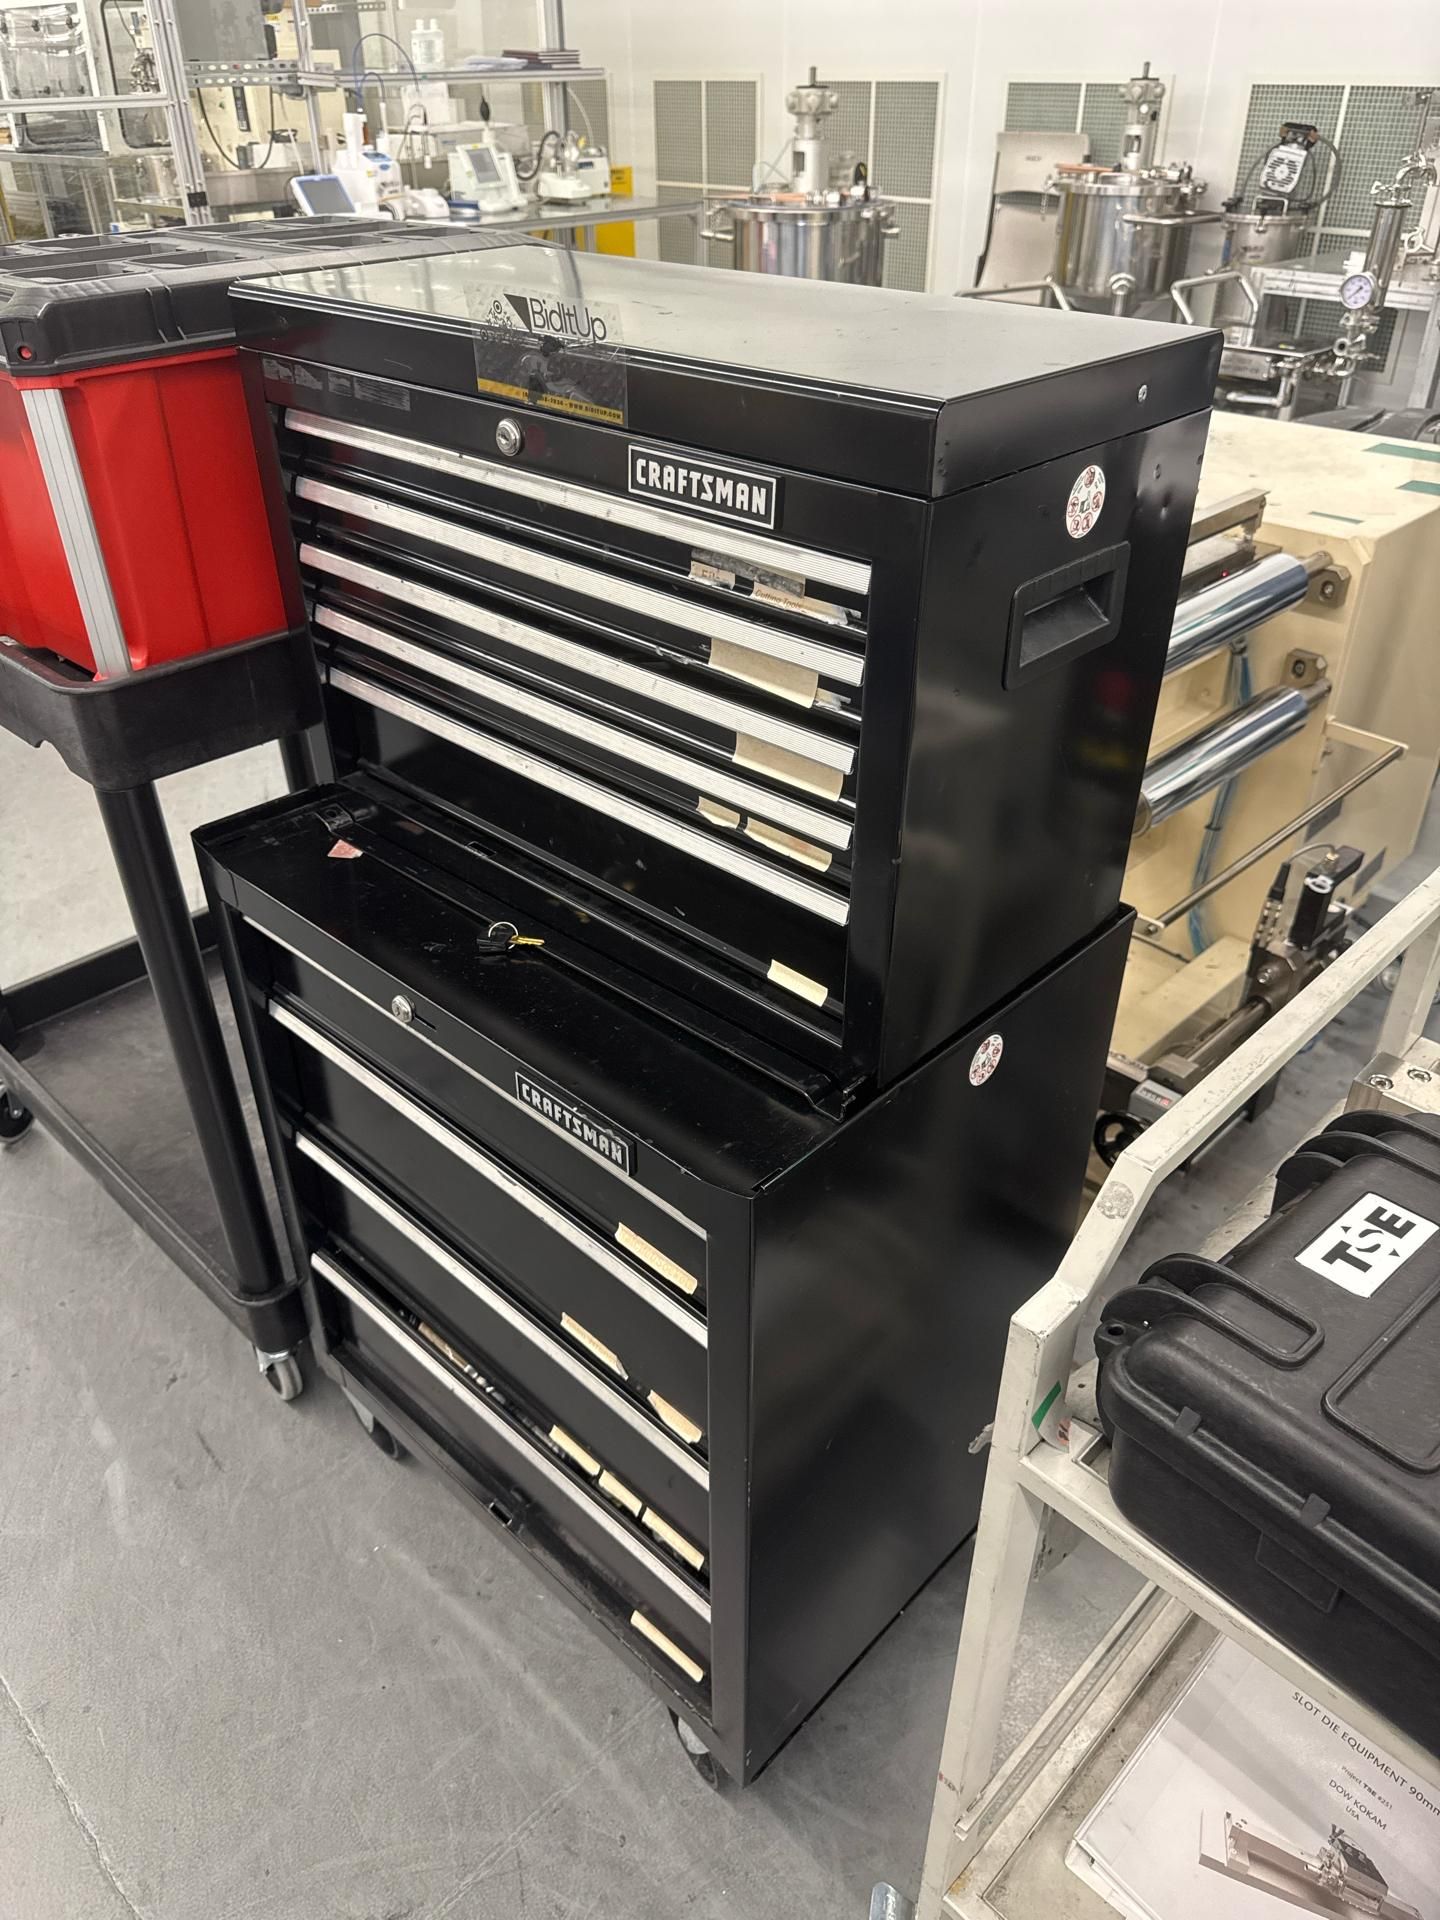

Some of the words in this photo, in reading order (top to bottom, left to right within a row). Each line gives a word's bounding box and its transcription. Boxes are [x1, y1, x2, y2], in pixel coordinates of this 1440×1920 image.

[529, 298, 607, 343] BidItUp
[636, 458, 767, 516] CRAFTSMAN
[521, 1083, 622, 1165] CRAFTSMAN
[1321, 1206, 1417, 1273] TSE
[1292, 1692, 1321, 1717] SLOT
[1320, 1714, 1340, 1734] DIE
[1341, 1732, 1408, 1787] EQUIPMENT
[1341, 1766, 1363, 1785] Project
[1329, 1779, 1352, 1801] DOW
[1353, 1799, 1388, 1831] KOKAM
[1345, 1806, 1360, 1821] USA
